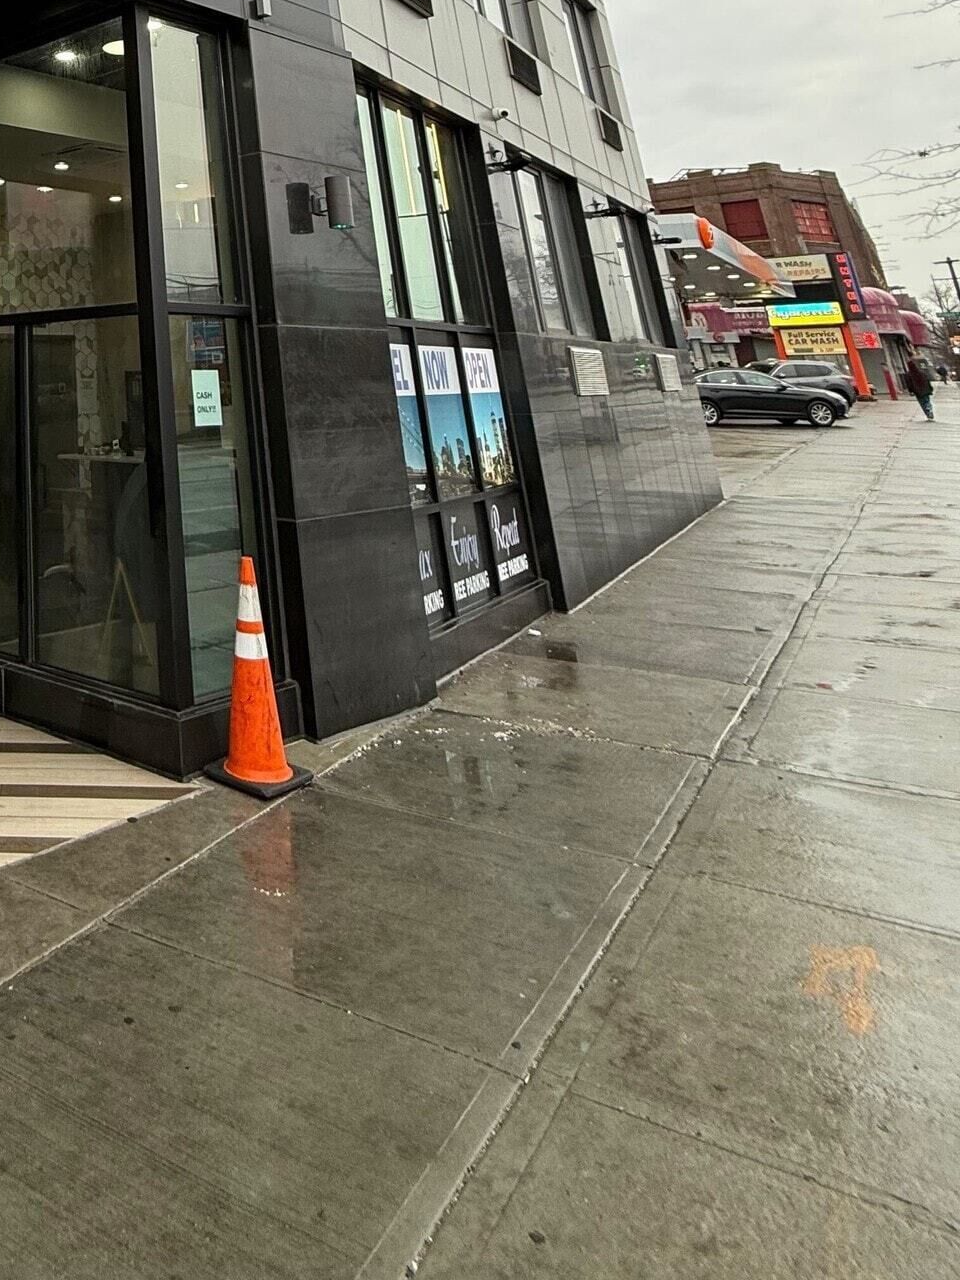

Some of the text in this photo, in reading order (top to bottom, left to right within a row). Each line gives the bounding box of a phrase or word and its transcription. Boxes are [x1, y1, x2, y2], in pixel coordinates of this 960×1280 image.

[788, 338, 808, 346] CAR
[805, 330, 836, 338] Service
[422, 350, 450, 390] NOW
[465, 352, 492, 389] OPEN
[450, 516, 480, 572] Enjoy
[507, 553, 529, 578] PARKING
[465, 569, 490, 597] PARKING
